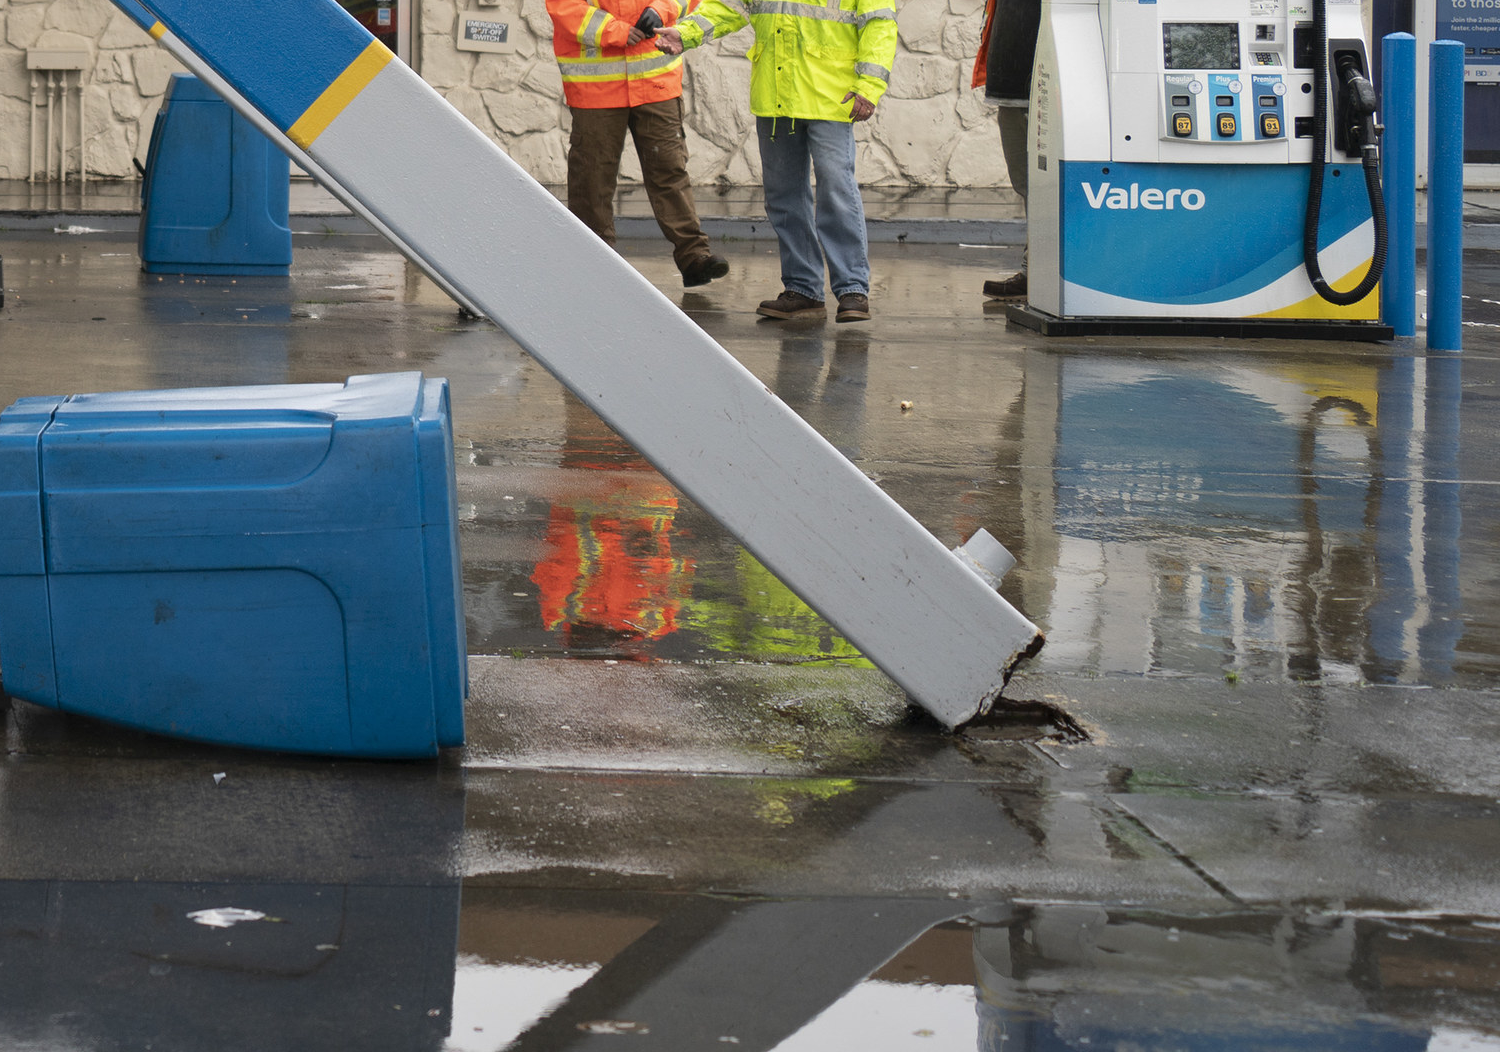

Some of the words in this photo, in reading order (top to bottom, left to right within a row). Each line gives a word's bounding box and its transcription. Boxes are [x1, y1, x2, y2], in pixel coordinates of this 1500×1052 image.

[467, 21, 507, 30] EMERGENCY
[473, 34, 500, 42] SWITCH
[1081, 182, 1205, 210] Valero
